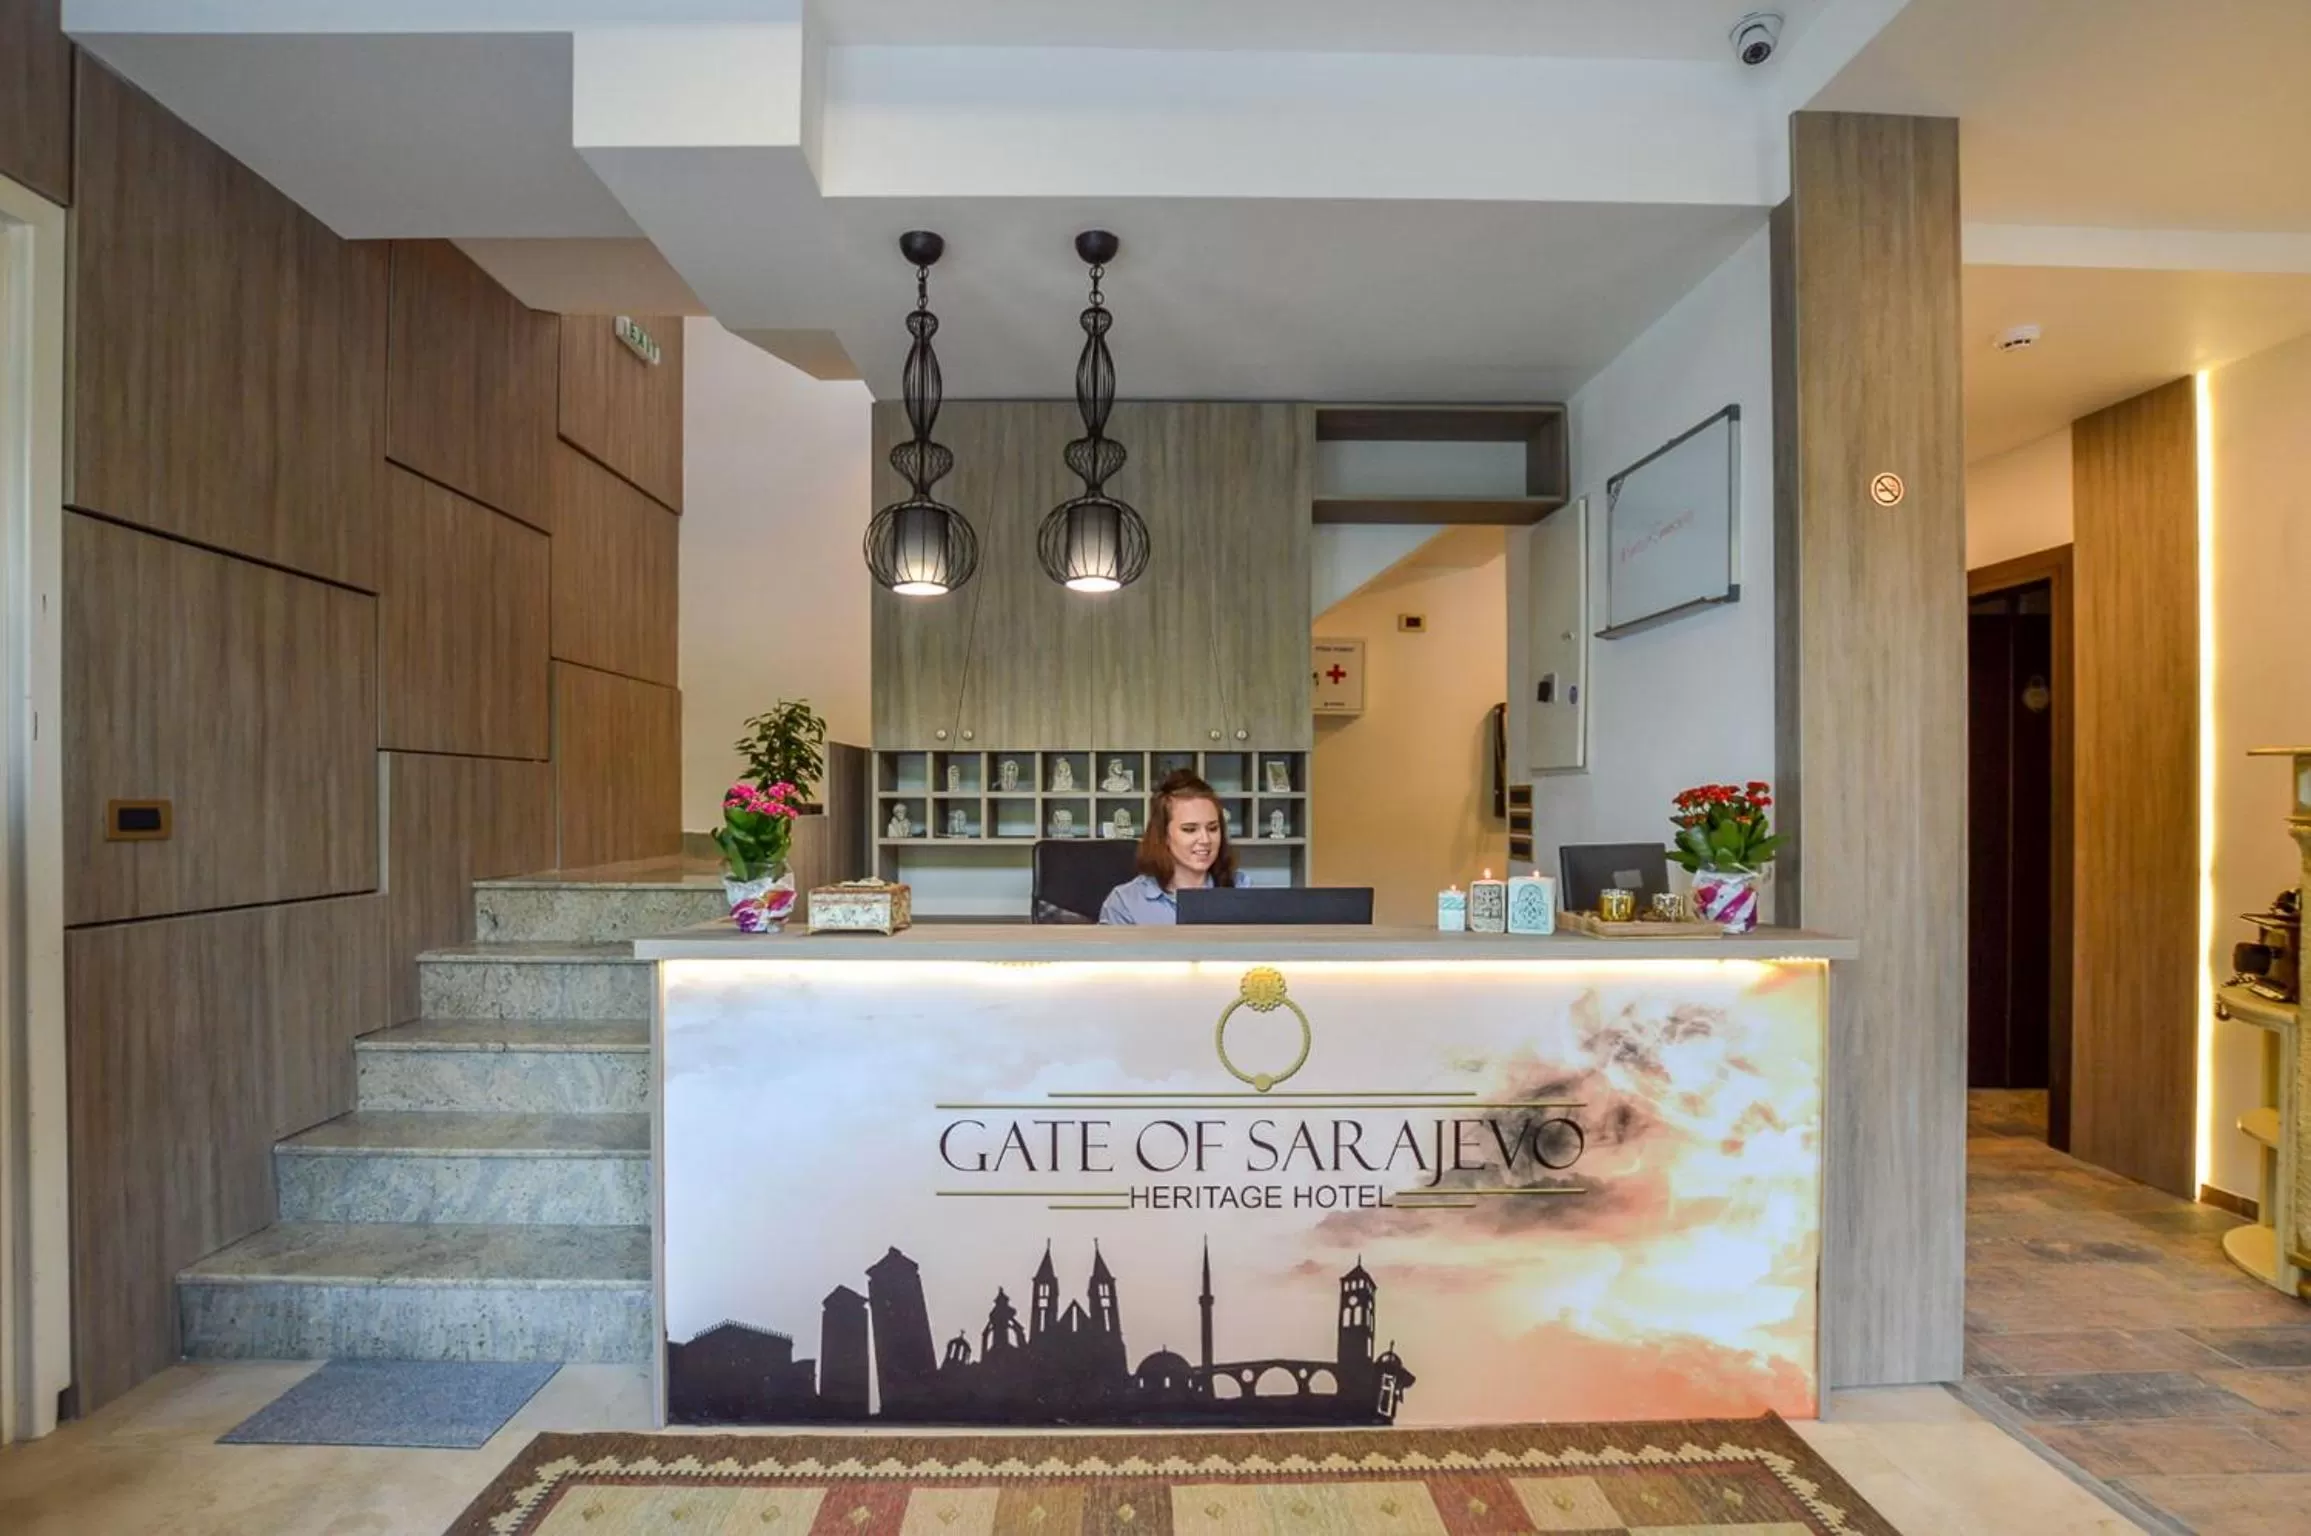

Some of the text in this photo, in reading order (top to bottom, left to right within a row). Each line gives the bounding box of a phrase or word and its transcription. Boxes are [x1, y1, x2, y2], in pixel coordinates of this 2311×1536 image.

[939, 1117, 1585, 1187] GATE OF SARAJEVO
[1130, 1184, 1394, 1209] HERITAGE HOTEL
